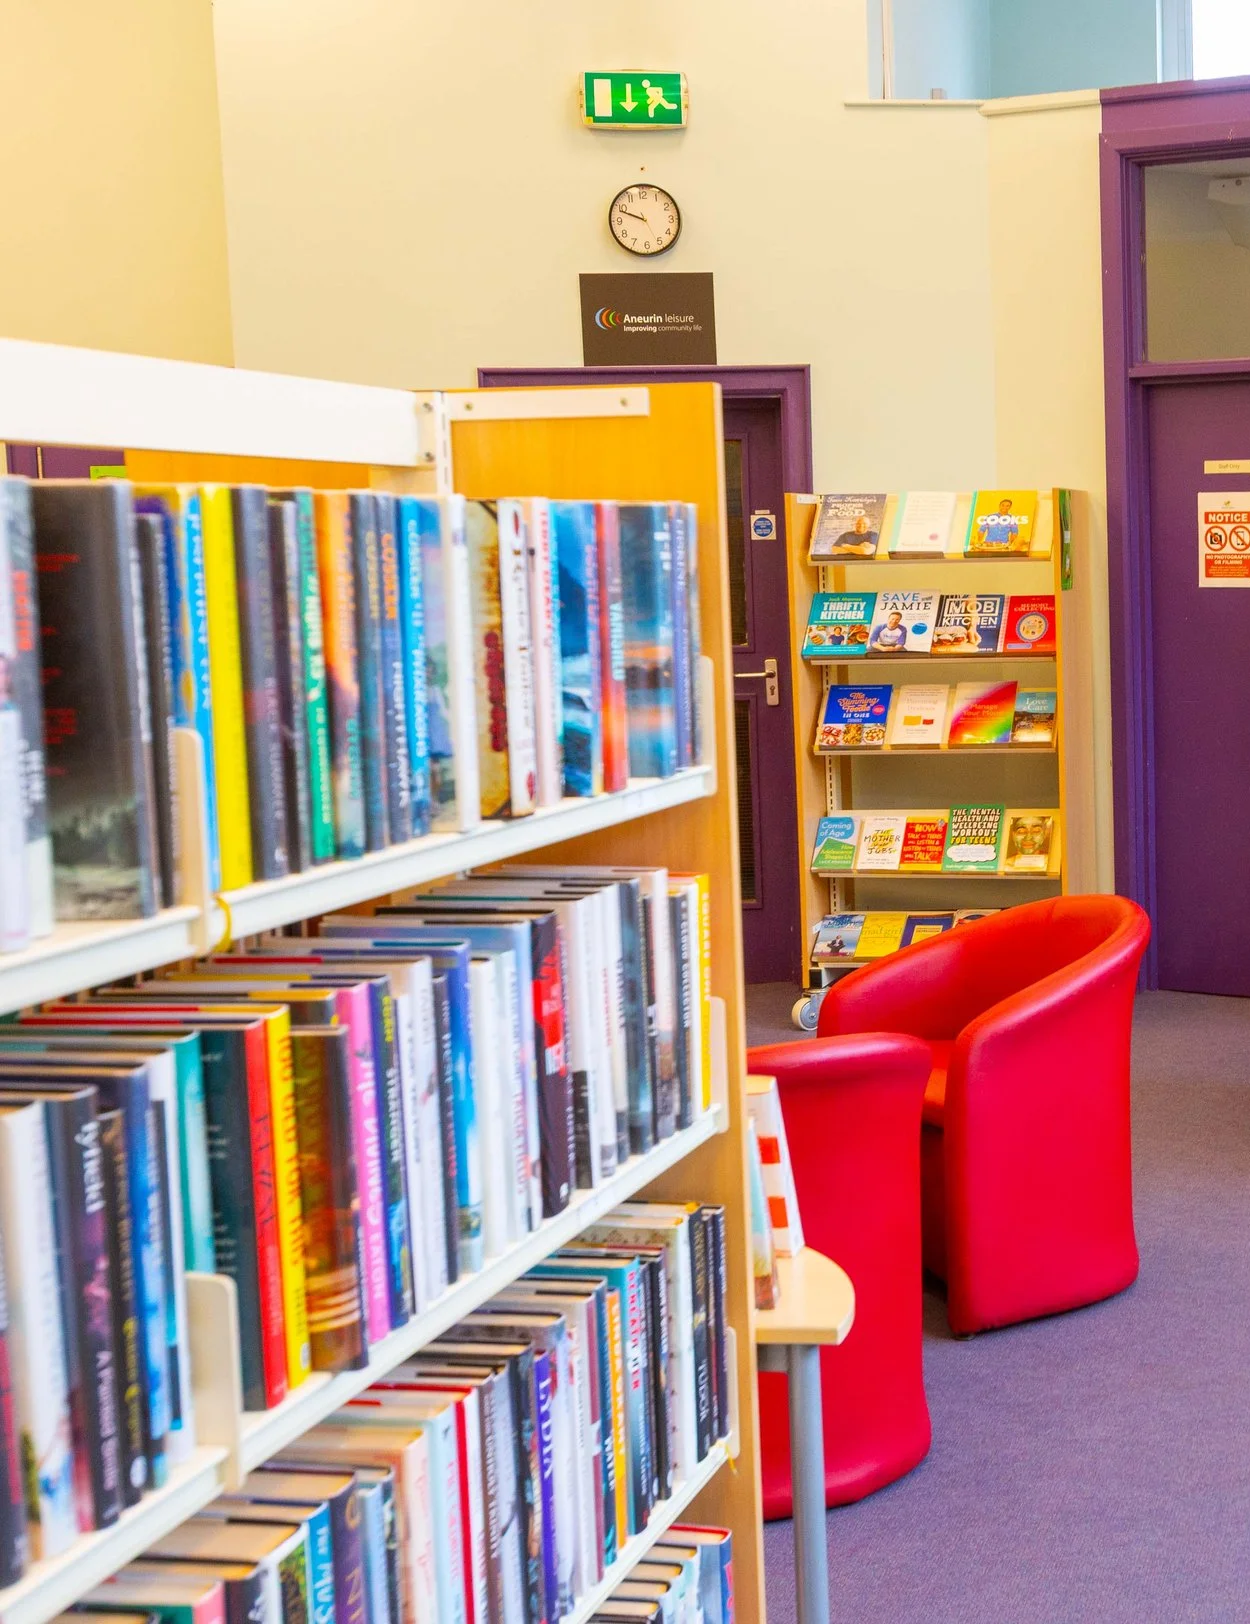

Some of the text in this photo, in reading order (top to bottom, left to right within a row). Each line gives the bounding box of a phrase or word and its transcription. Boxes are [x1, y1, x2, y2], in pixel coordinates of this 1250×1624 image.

[627, 194, 634, 203] 11
[638, 190, 647, 200] 12
[654, 193, 658, 202] 1
[664, 202, 670, 211] 2
[616, 217, 623, 226] 9
[668, 215, 674, 224] 3
[621, 229, 628, 238] 8
[631, 238, 637, 246] 7
[644, 241, 650, 249] 6
[657, 237, 663, 246] 5
[623, 314, 694, 323] Aneurin leisure
[624, 325, 657, 333] Improving
[976, 514, 1029, 526] COOKS
[1208, 513, 1248, 522] NOTICE
[882, 592, 920, 602] SAVE
[823, 601, 866, 611] THRIFTY
[880, 602, 932, 611] JAMIE
[949, 601, 995, 615] MOB
[820, 610, 865, 620] KITCHEN
[821, 821, 852, 830] Coming
[829, 829, 845, 837] Age
[952, 829, 997, 837] WORKOUT
[537, 1377, 554, 1482] LYDIA
